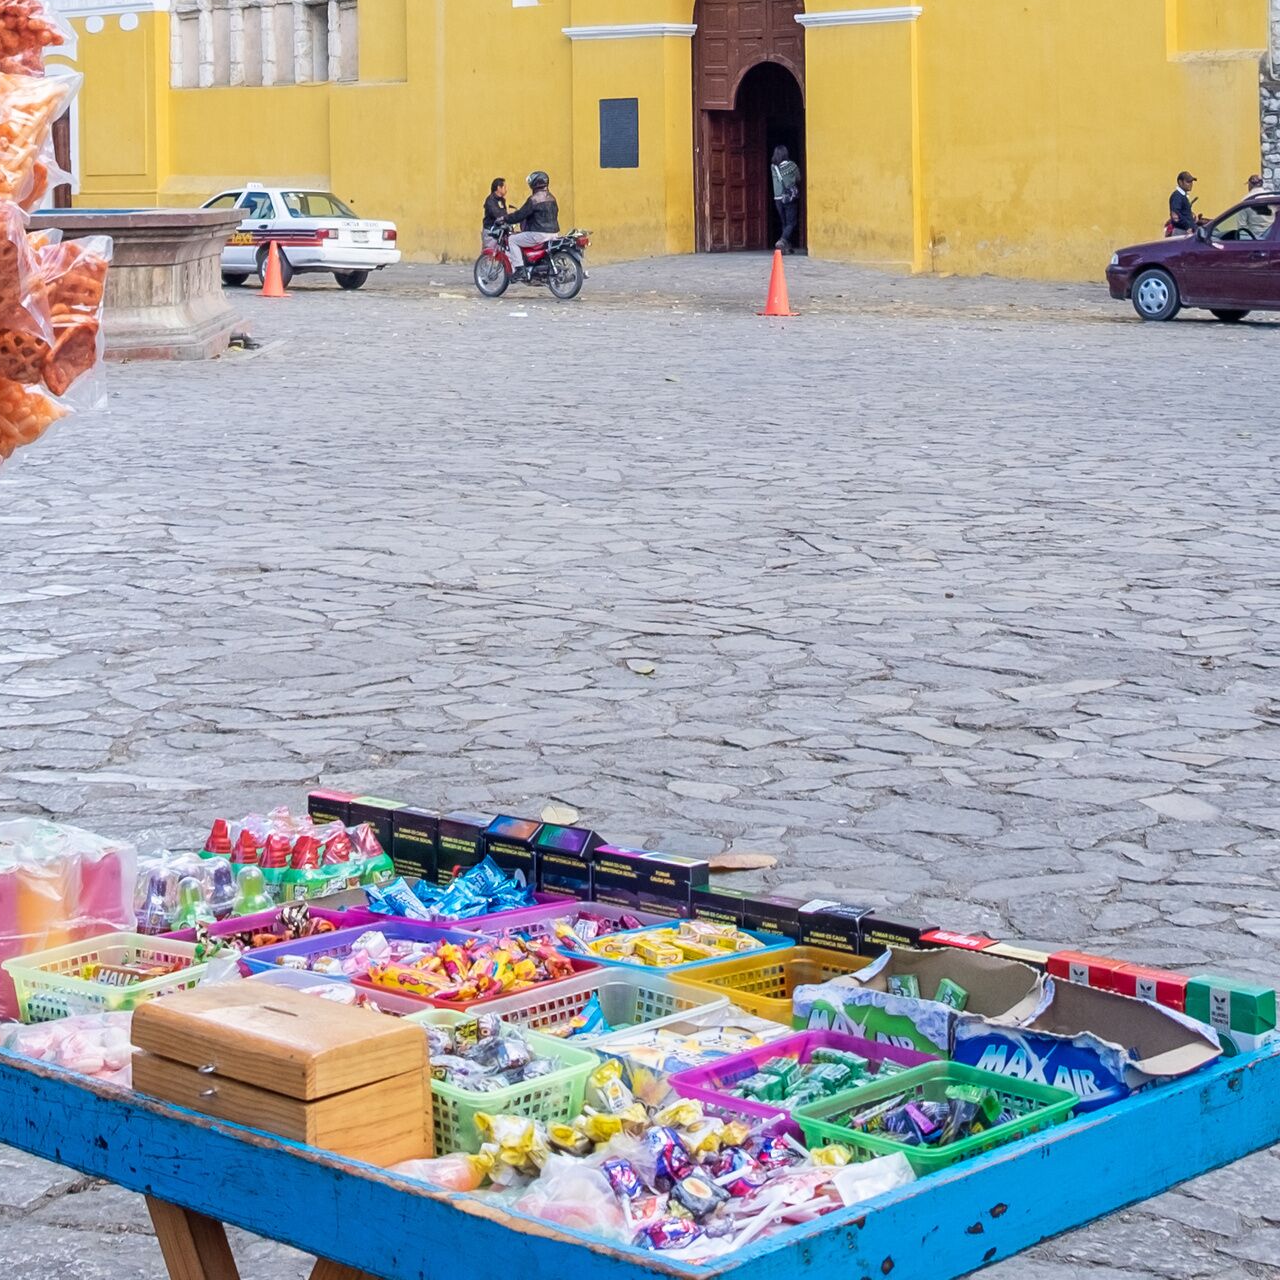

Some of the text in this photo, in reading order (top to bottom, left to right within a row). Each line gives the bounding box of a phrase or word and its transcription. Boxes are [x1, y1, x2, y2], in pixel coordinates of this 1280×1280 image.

[806, 1008, 868, 1040] MAX
[972, 1043, 1102, 1096] MAX AIR
